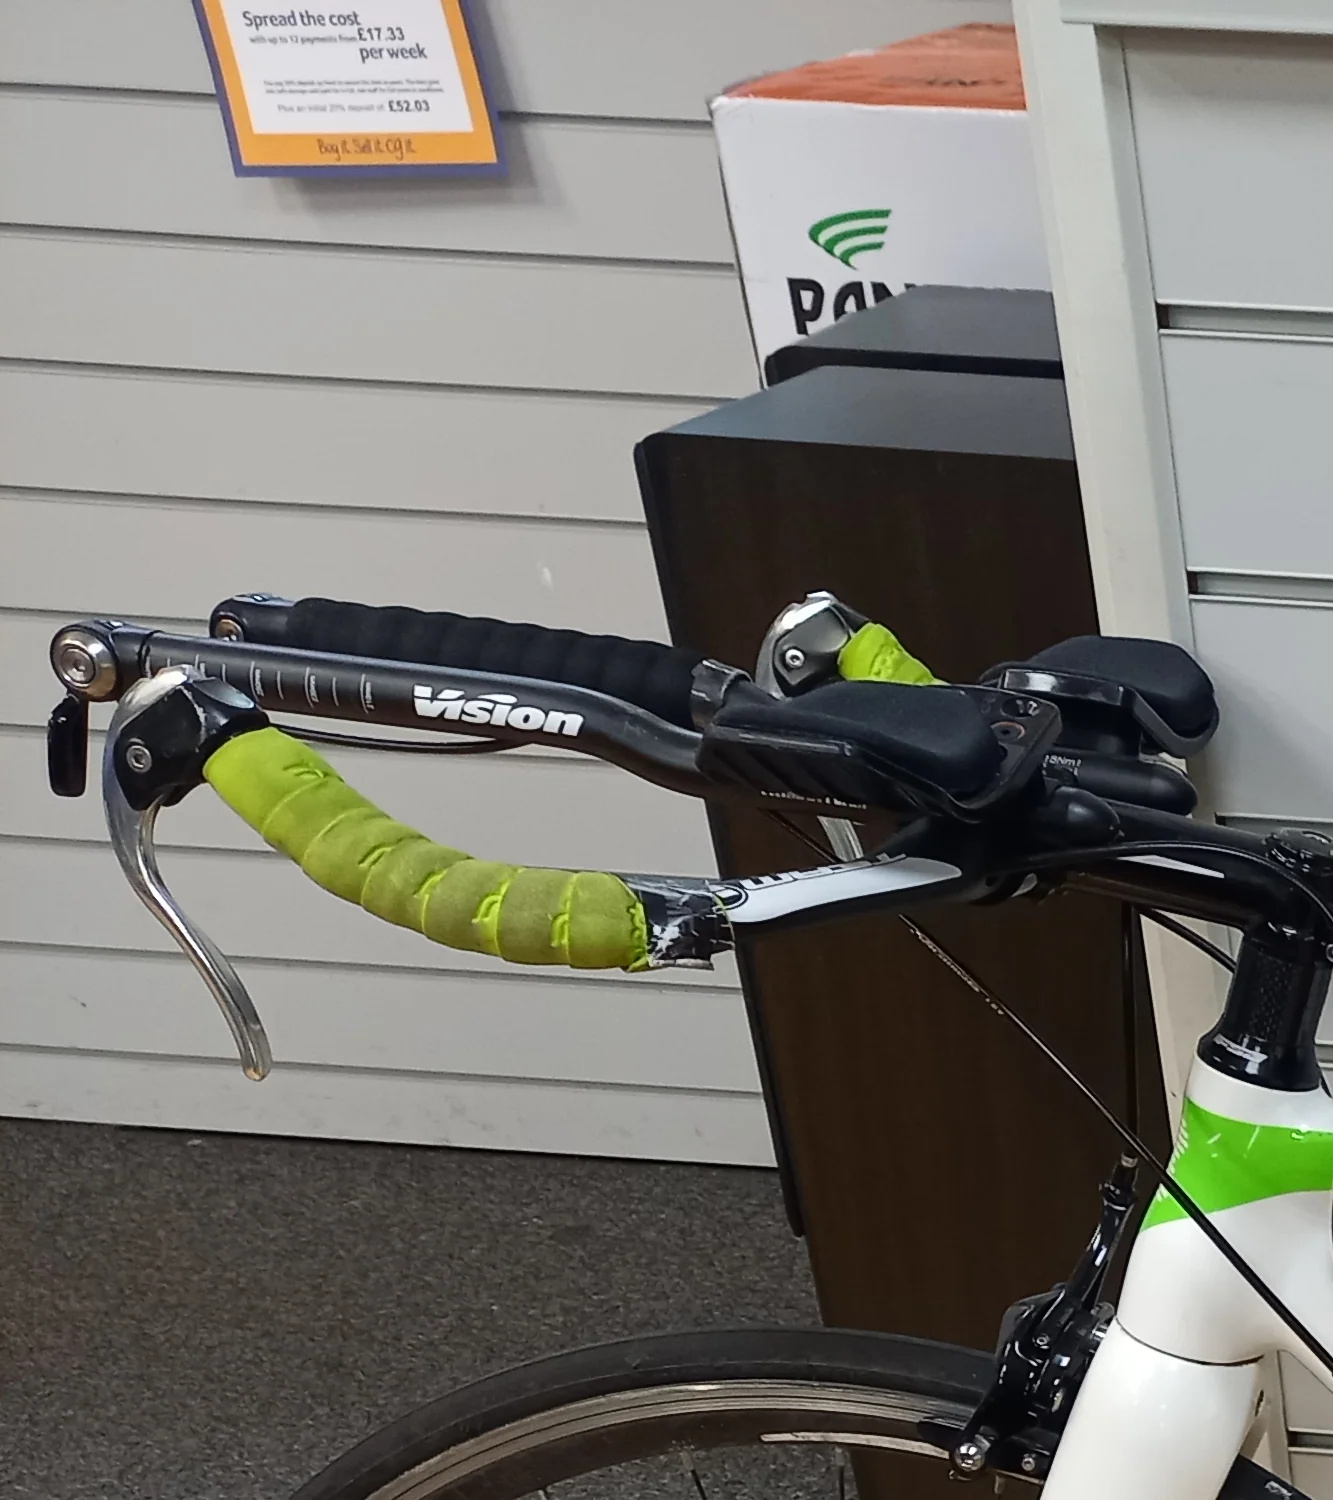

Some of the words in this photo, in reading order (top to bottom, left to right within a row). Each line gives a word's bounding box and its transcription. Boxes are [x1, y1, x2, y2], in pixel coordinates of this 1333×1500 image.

[242, 10, 298, 31] Spread
[299, 10, 326, 26] the
[329, 11, 361, 27] cost
[357, 27, 405, 42] £17.33
[359, 45, 385, 64] per
[387, 43, 428, 60] week
[388, 99, 430, 113] £52.03
[412, 684, 585, 738] Vision
